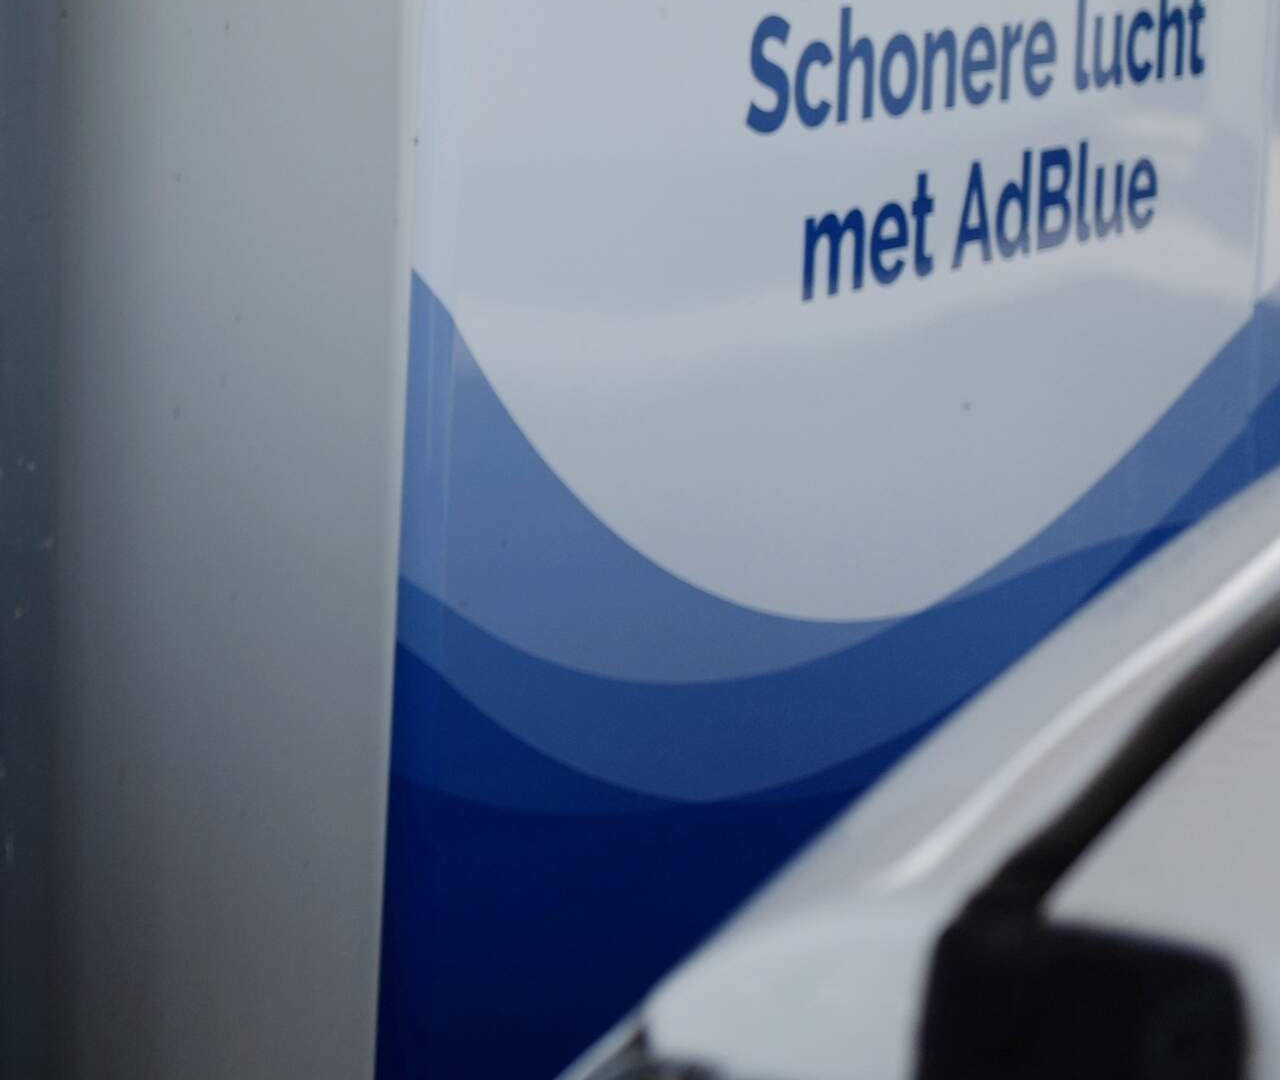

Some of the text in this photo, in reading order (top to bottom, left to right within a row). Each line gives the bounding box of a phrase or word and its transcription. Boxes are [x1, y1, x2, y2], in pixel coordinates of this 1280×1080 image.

[744, 5, 1058, 135] Schonere
[800, 139, 1159, 303] met AdBlue
